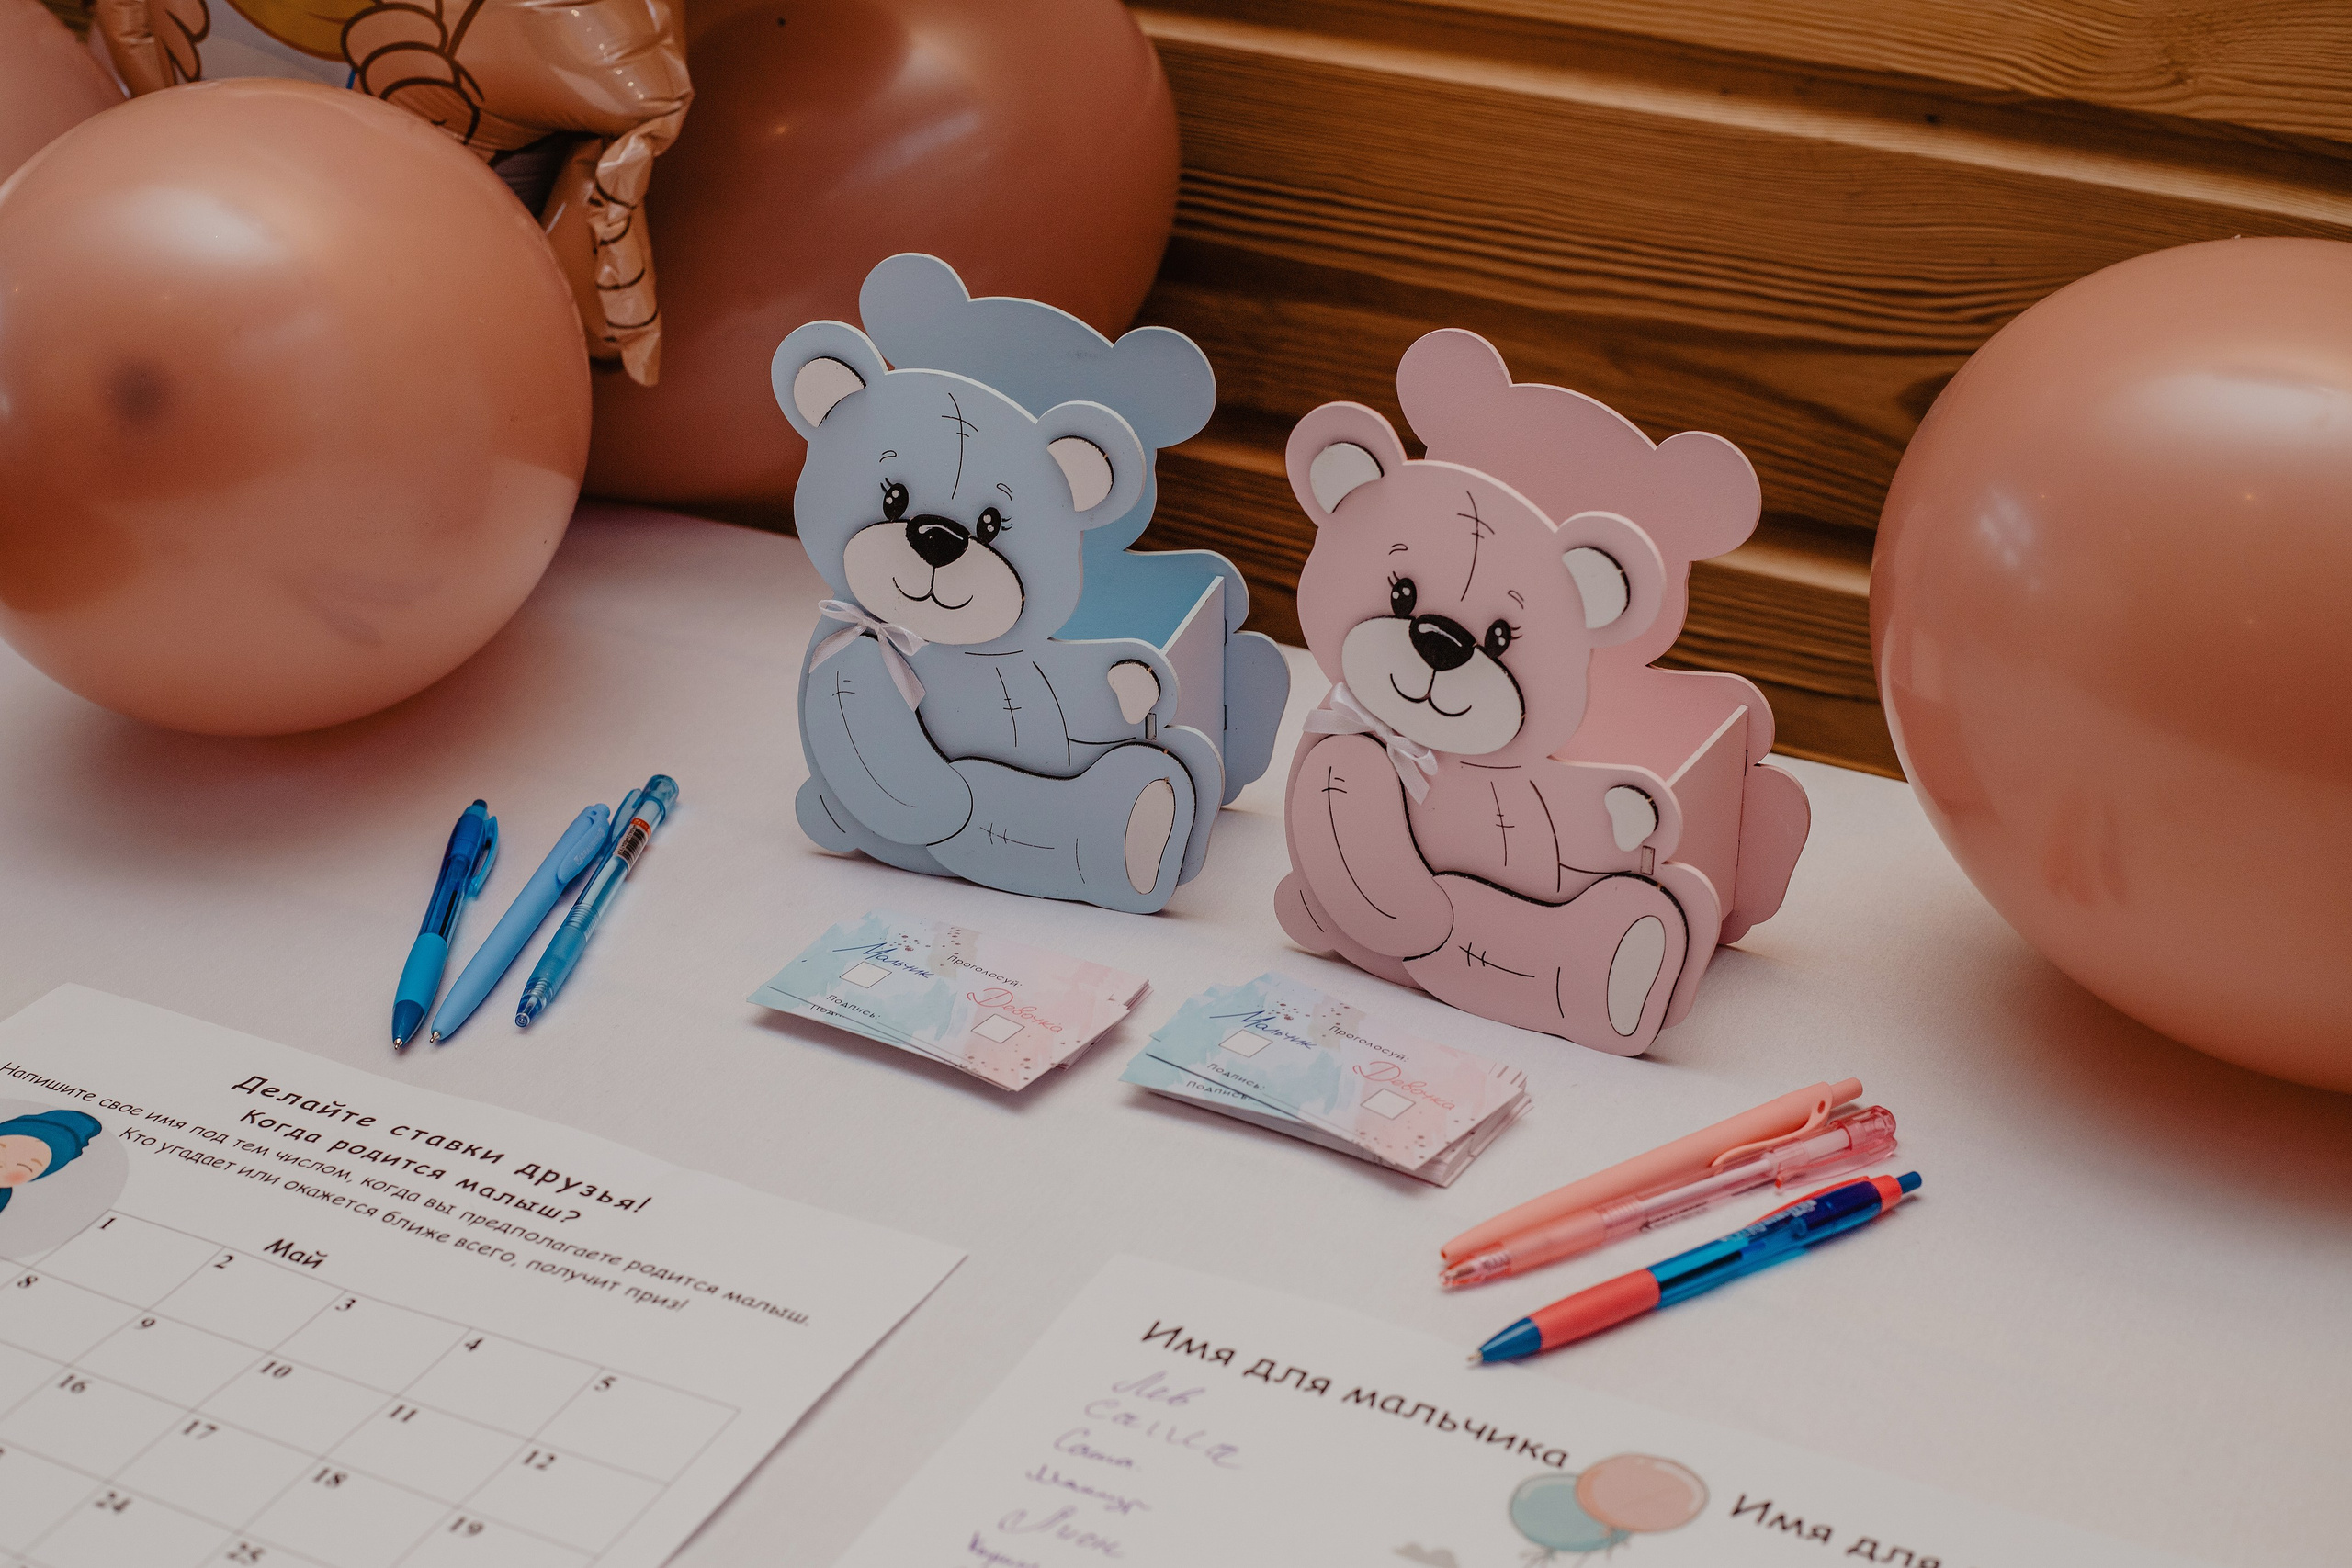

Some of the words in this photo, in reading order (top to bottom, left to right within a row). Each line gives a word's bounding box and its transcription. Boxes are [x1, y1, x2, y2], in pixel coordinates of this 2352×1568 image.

[832, 942, 935, 979] Мальчик
[946, 954, 1023, 989] Проголосуй:
[826, 994, 881, 1021] Подпись:
[967, 987, 1064, 1034] Девочка
[1210, 1010, 1317, 1050] Мальчик
[1329, 1025, 1409, 1061] Проголосуй:
[1207, 1063, 1266, 1091] Подпись:
[1352, 1061, 1456, 1111] Девочка
[231, 1075, 378, 1128] Делайте
[390, 1122, 505, 1164] ставки
[514, 1162, 652, 1213] друзья!
[240, 1108, 322, 1144] Когда
[327, 1137, 447, 1180] родится
[455, 1176, 582, 1224] малыш?
[0, 1061, 96, 1102] Напишите
[98, 1096, 143, 1117] свое
[146, 1110, 187, 1130] имя
[189, 1124, 229, 1145] под
[232, 1139, 270, 1157] тем
[276, 1149, 354, 1184] числом,
[360, 1175, 421, 1204] когда
[424, 1197, 457, 1216] вы
[458, 1209, 624, 1266] предполагаете
[623, 1258, 719, 1295] родится
[722, 1291, 810, 1327] малыш.
[97, 1216, 117, 1231] 1
[119, 1126, 158, 1147] Кто
[160, 1142, 236, 1172] угадает
[237, 1165, 280, 1186] или
[283, 1178, 379, 1217] окажется
[380, 1208, 451, 1244] ближе
[453, 1236, 518, 1267] всего,
[526, 1257, 622, 1292] получит
[623, 1285, 690, 1314] приз!
[214, 1255, 235, 1269] 2
[264, 1238, 329, 1270] Май
[17, 1274, 38, 1289] 8
[334, 1298, 357, 1312] 3
[135, 1317, 156, 1330] 9
[464, 1337, 484, 1351] 4
[260, 1360, 292, 1378] 10
[59, 1374, 87, 1393] 16
[594, 1376, 616, 1392] 5
[1141, 1320, 1237, 1367] Имя
[1243, 1357, 1332, 1396] для
[1341, 1385, 1570, 1470] мальчика
[389, 1404, 419, 1423] 11
[182, 1419, 219, 1439] 17
[522, 1449, 557, 1471] 12
[313, 1468, 347, 1488] 18
[95, 1491, 132, 1514] 24
[449, 1517, 485, 1538] 19
[1730, 1493, 1835, 1545] Имя
[1845, 1536, 1942, 1568] для
[227, 1541, 266, 1564] 25
